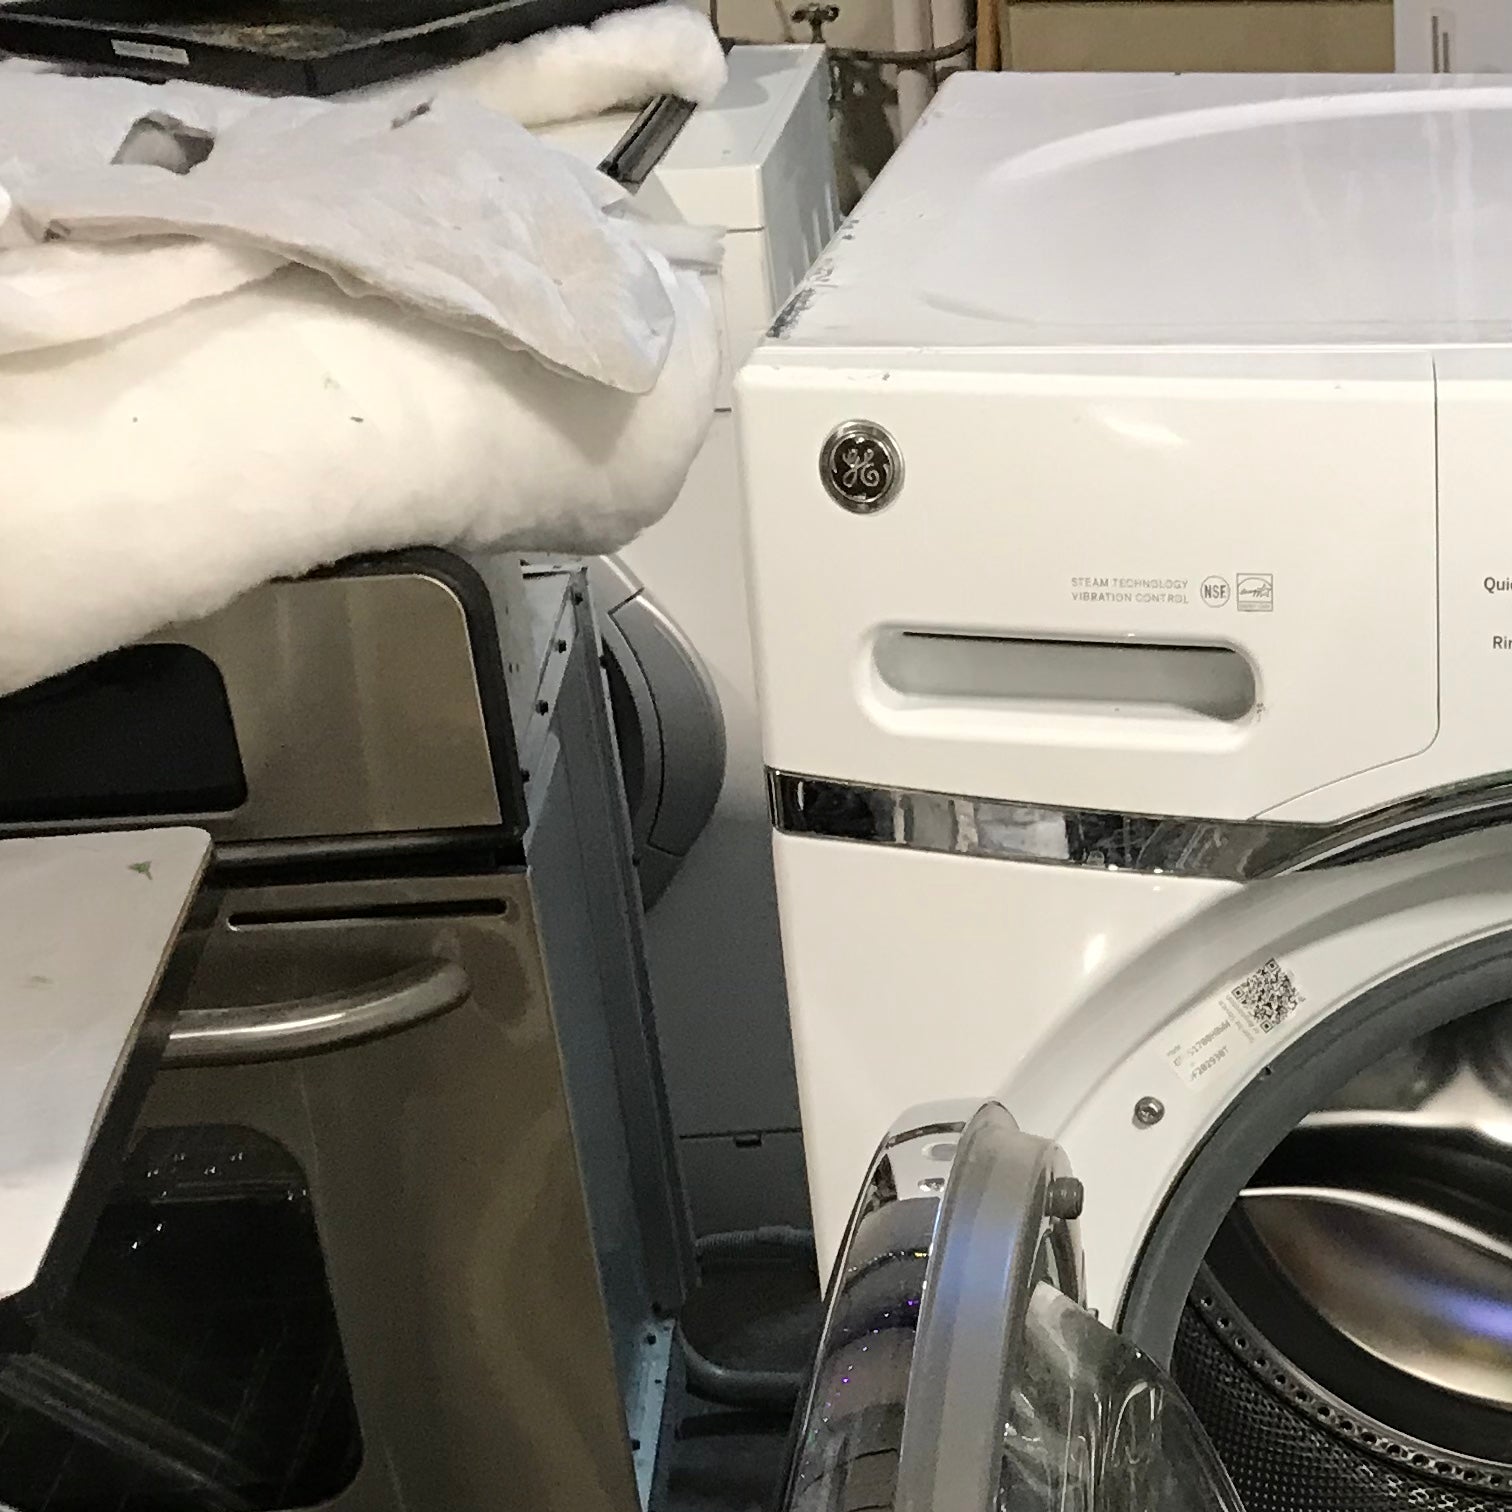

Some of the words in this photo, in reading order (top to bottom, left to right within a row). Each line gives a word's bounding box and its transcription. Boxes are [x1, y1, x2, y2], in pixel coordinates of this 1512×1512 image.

[1071, 577, 1109, 588] STEAM
[1112, 578, 1189, 589] TECHNOLOGY
[1071, 592, 1133, 603] VIBRATION
[1135, 593, 1189, 604] CONTROL
